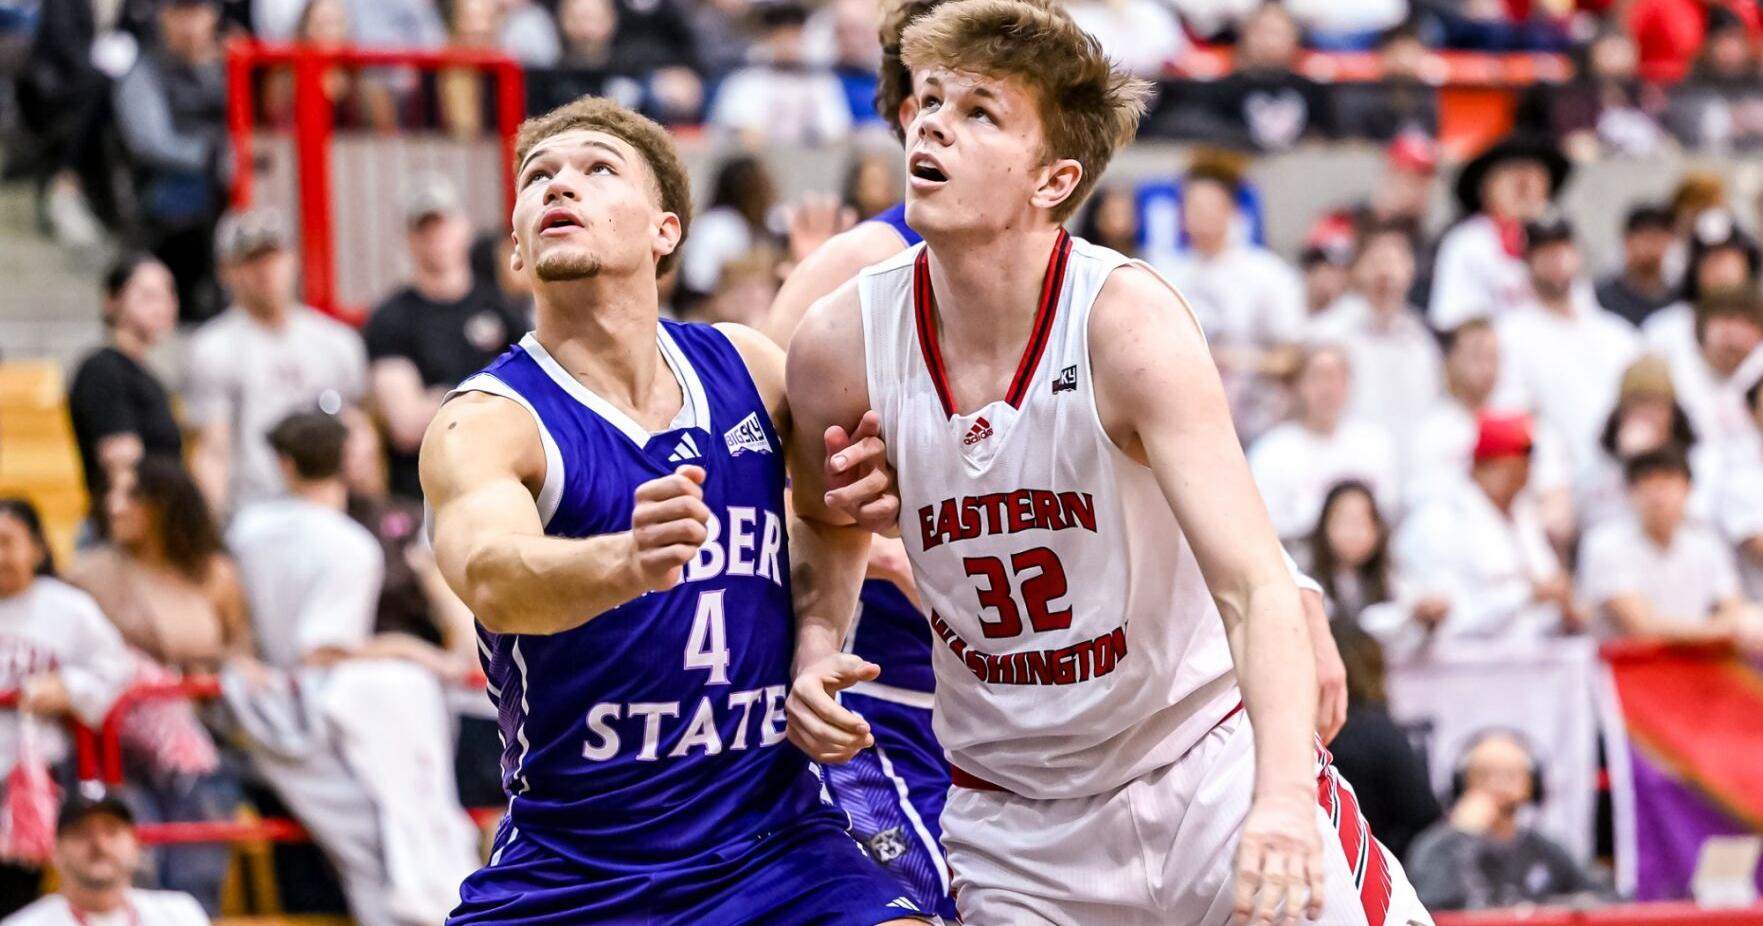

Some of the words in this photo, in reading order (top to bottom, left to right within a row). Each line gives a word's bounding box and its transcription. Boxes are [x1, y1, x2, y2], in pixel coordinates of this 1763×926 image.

[963, 427, 994, 446] adidas
[674, 505, 783, 588] BER
[918, 488, 1098, 552] EASTERN
[963, 546, 1073, 639] 32
[683, 588, 732, 686] 4
[582, 684, 787, 762] STATE
